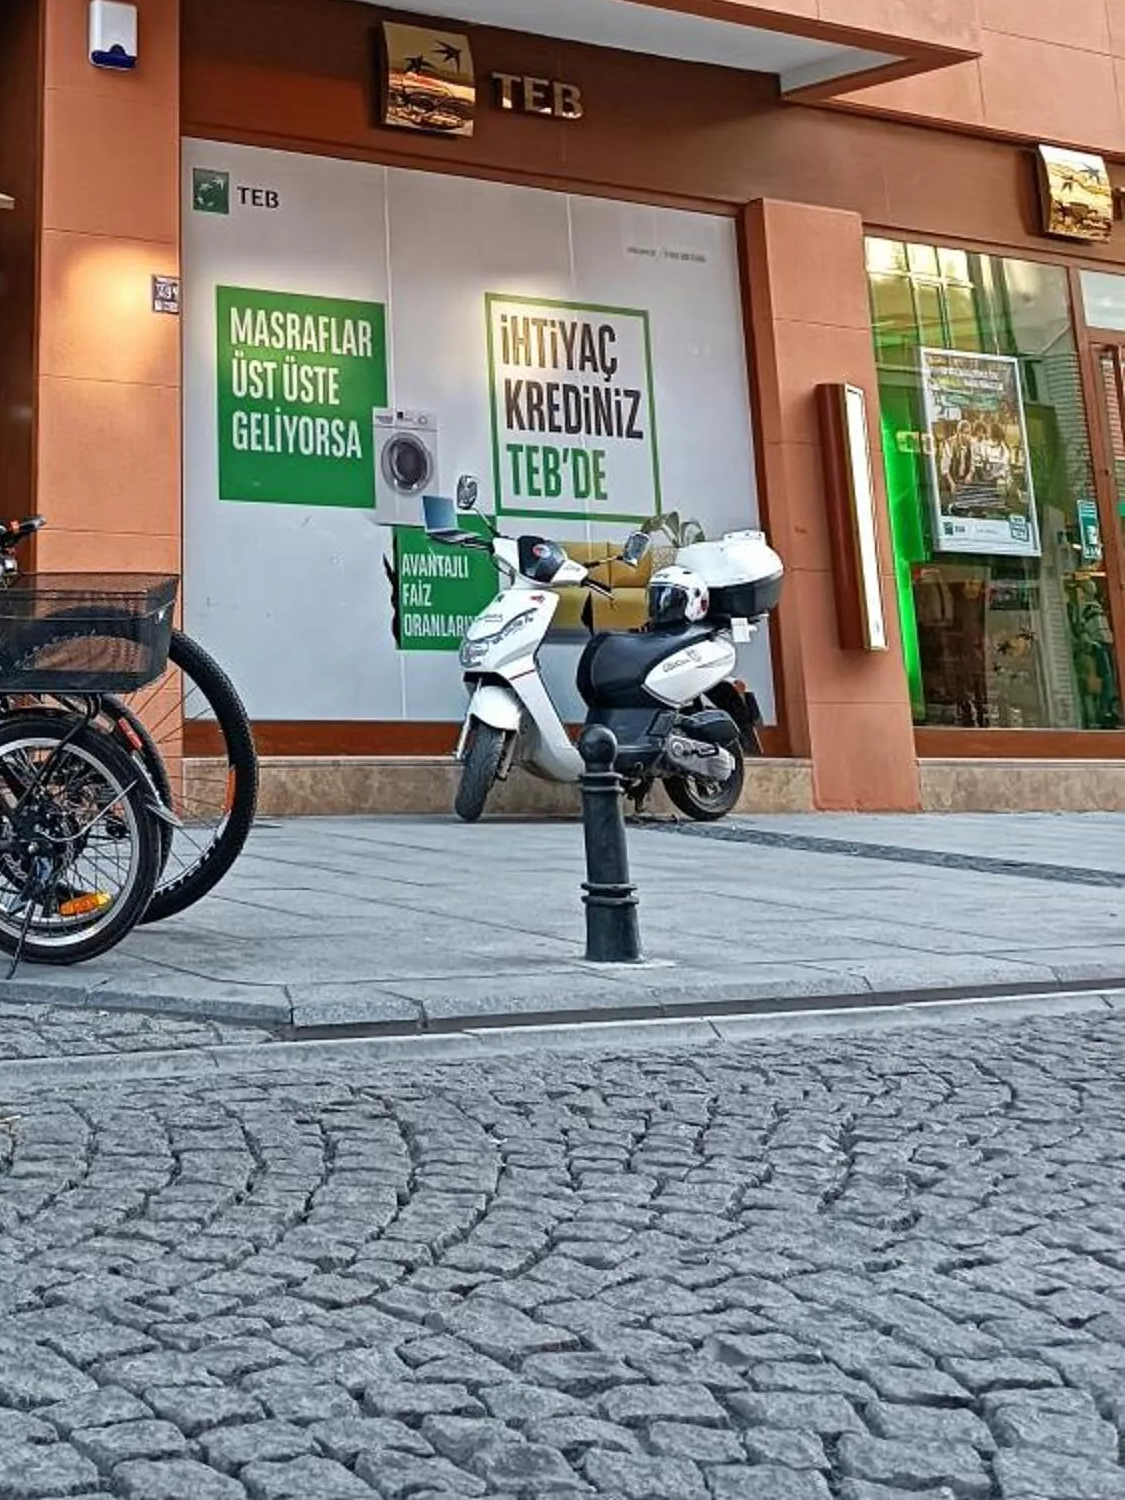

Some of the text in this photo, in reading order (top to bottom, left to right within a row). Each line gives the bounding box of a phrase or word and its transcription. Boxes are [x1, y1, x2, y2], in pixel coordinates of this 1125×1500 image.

[491, 71, 584, 120] TEB
[237, 186, 279, 209] TEB
[230, 307, 373, 358] MASRAFLAR
[232, 350, 340, 405] ÜST ÜSTE
[232, 406, 363, 460] GELİYORSA
[506, 443, 608, 501] TEB'DE
[402, 552, 469, 578] AVANTAJLI
[403, 580, 432, 607] FAİZ
